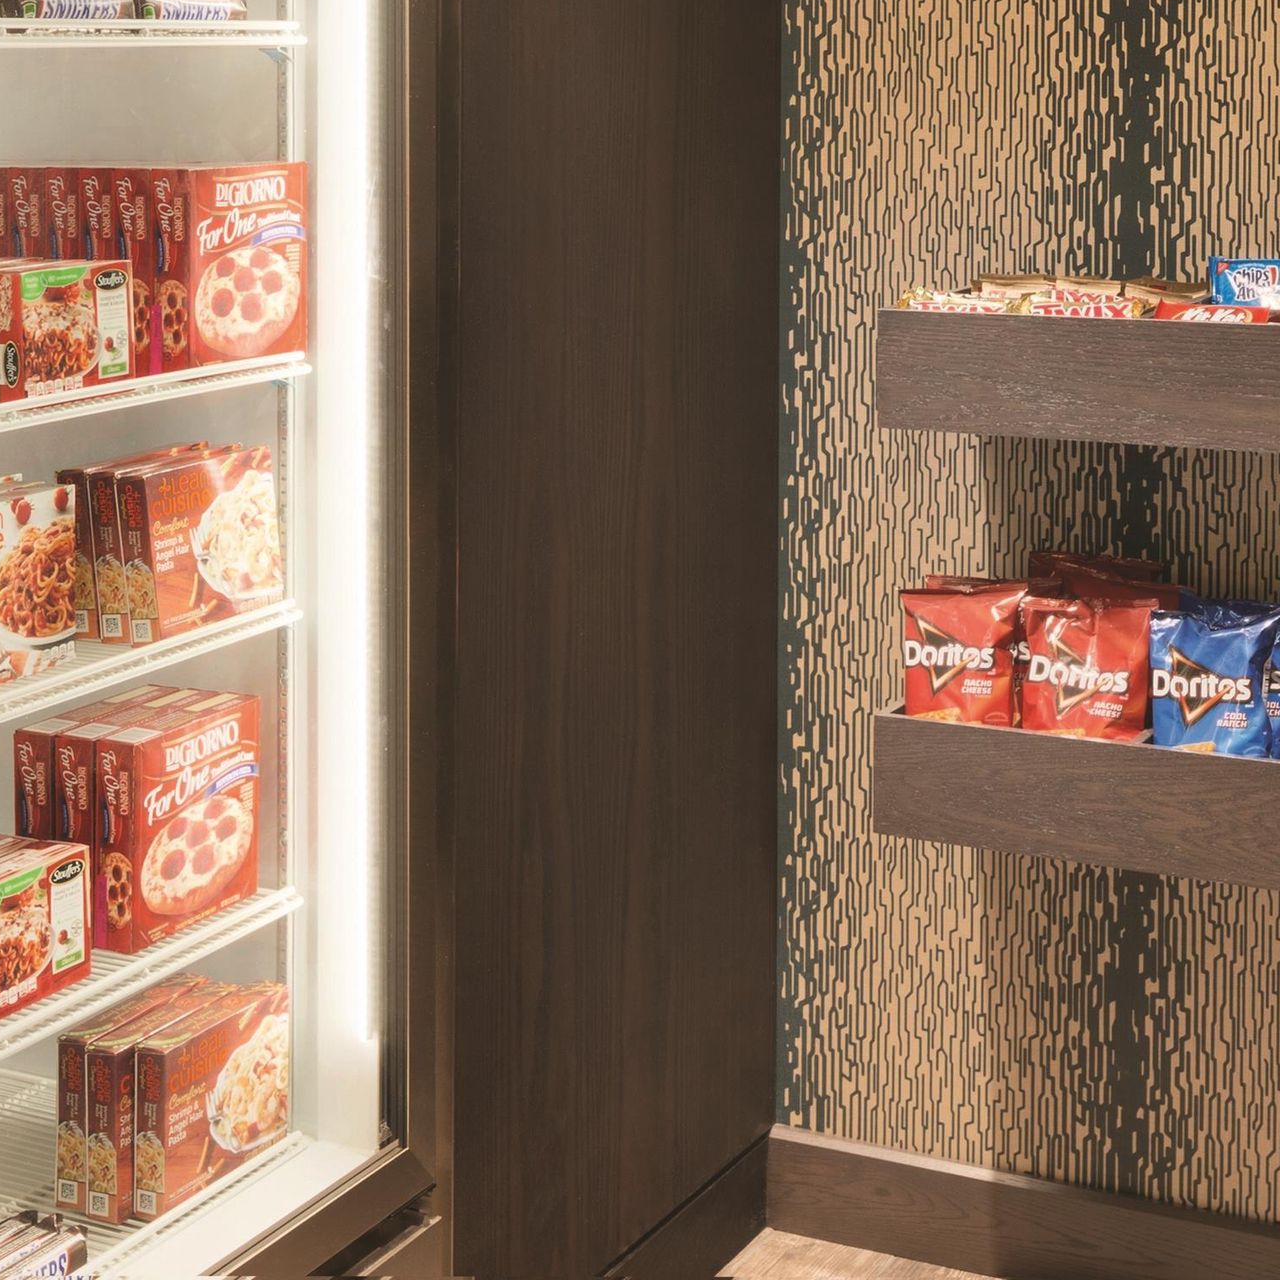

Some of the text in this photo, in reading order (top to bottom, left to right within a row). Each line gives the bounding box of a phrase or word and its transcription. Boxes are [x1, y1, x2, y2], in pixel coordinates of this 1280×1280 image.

[215, 176, 285, 207] DIGIORNO
[196, 207, 257, 256] For One
[1034, 304, 1132, 319] TWIX
[904, 640, 995, 670] Doritos
[964, 679, 993, 688] NACHO
[1028, 654, 1129, 694] Doritos
[1152, 668, 1251, 701] Doritos
[961, 685, 993, 695] CHEESE
[1089, 707, 1122, 719] CHEESE
[1093, 701, 1123, 712] NACHO
[1223, 712, 1248, 720] COOL
[1216, 719, 1249, 729] RANCH
[165, 720, 239, 772] DIGIORNO
[143, 764, 210, 826] For One
